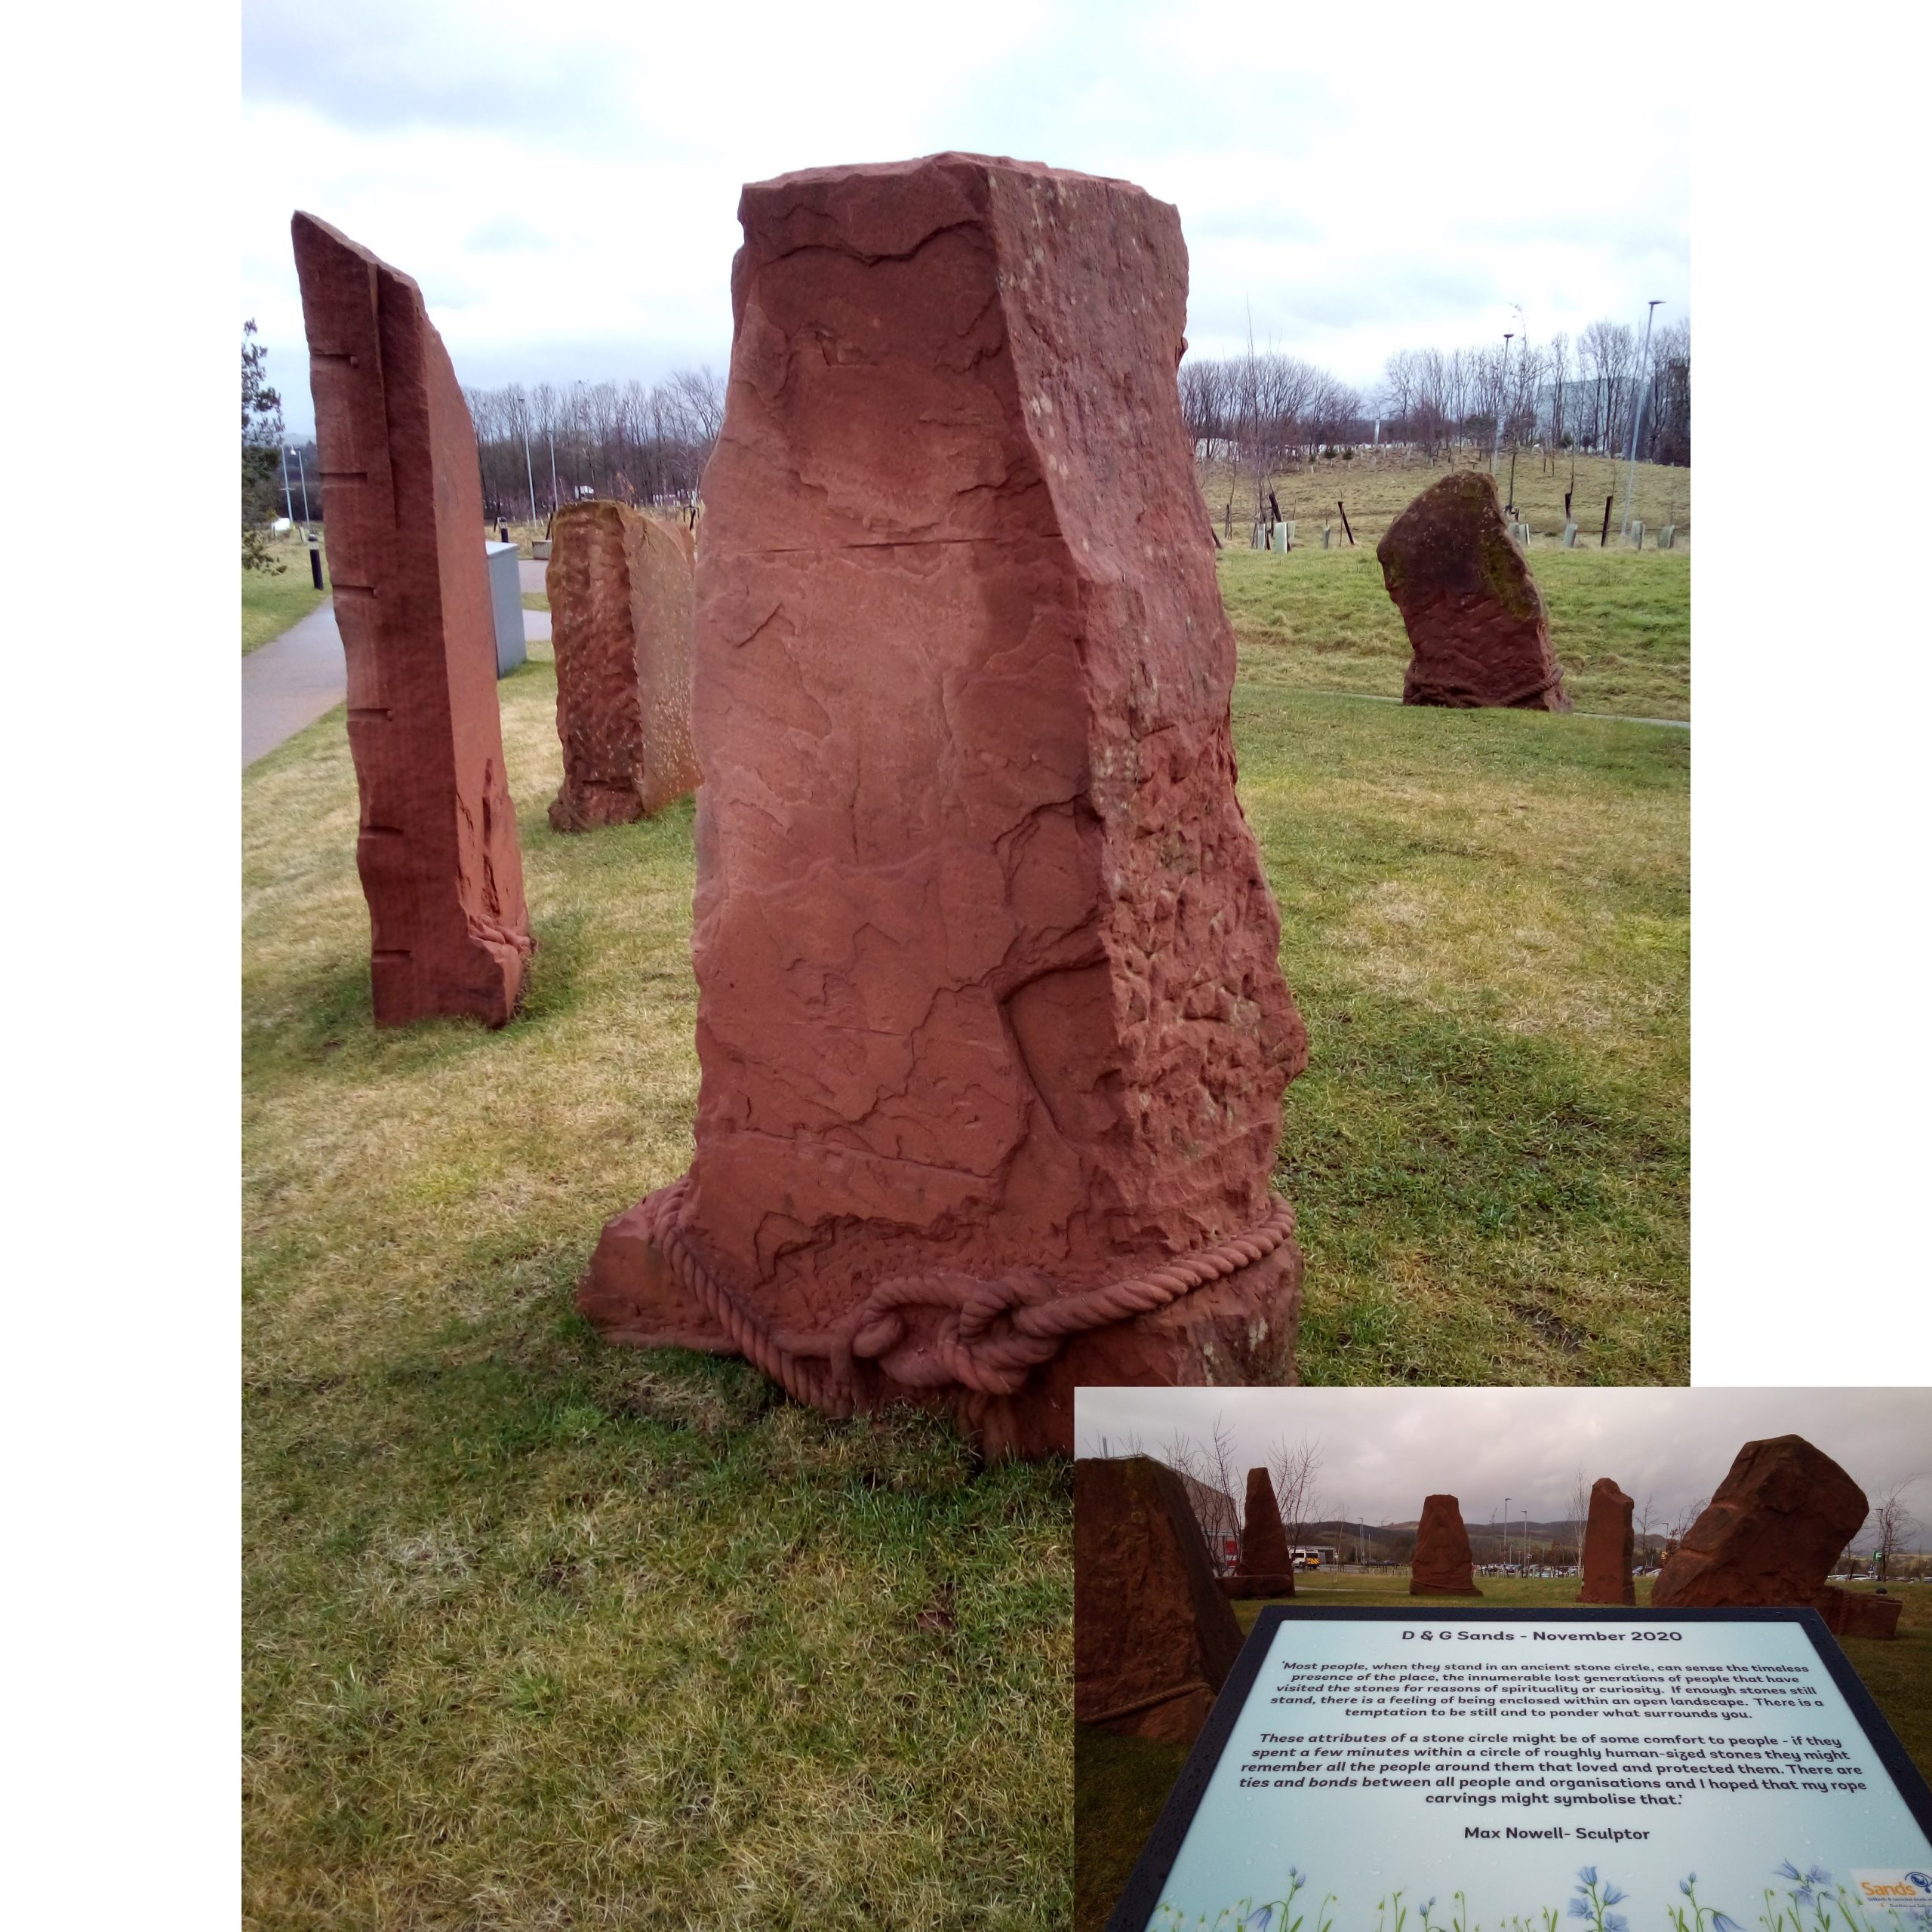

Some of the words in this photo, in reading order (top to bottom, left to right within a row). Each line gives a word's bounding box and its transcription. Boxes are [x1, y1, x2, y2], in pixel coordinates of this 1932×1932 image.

[1402, 1631, 1414, 1639] D
[1420, 1631, 1433, 1641] &
[1439, 1632, 1451, 1640] G
[1457, 1631, 1514, 1640] Sands
[1534, 1632, 1626, 1641] November
[1631, 1632, 1682, 1641] 2020
[1321, 1663, 1367, 1672] people,
[1411, 1663, 1440, 1672] they
[1399, 1674, 1438, 1682] place,
[1584, 1675, 1665, 1684] generations
[1685, 1675, 1730, 1684] people
[1502, 1685, 1578, 1694] spirituality
[1600, 1686, 1664, 1695] curiosity.
[1685, 1686, 1737, 1696] enough
[1270, 1696, 1315, 1705] stand,
[1389, 1696, 1436, 1706] feeling
[1459, 1696, 1495, 1706] being
[1671, 1697, 1748, 1708] landscape.
[1346, 1708, 1426, 1718] temptation
[1470, 1708, 1497, 1716] still
[1550, 1709, 1599, 1718] ponder
[1603, 1709, 1640, 1717] what
[1644, 1709, 1718, 1718] surrounds
[1260, 1734, 1304, 1743] These
[1309, 1734, 1386, 1743] attributes
[1391, 1734, 1407, 1742] of
[1469, 1734, 1508, 1742] circle
[1512, 1734, 1556, 1745] might
[1560, 1734, 1577, 1743] be
[1582, 1734, 1596, 1743] of
[1644, 1735, 1706, 1744] comfort
[1728, 1736, 1778, 1747] people
[1791, 1737, 1802, 1745] if
[1806, 1737, 1841, 1748] they
[1251, 1749, 1297, 1759] spent
[1315, 1747, 1343, 1756] few
[1347, 1747, 1409, 1756] minutes
[1414, 1747, 1462, 1756] within
[1480, 1747, 1520, 1756] circle
[1525, 1748, 1540, 1756] of
[1544, 1748, 1601, 1760] roughly
[1605, 1748, 1706, 1761] human-sized
[1710, 1750, 1761, 1758] stones
[1764, 1750, 1801, 1761] they
[1804, 1750, 1850, 1762] might
[1241, 1761, 1323, 1771] remember
[1327, 1762, 1346, 1771] all
[1350, 1761, 1375, 1771] the
[1380, 1761, 1430, 1774] people
[1435, 1761, 1490, 1771] around
[1494, 1761, 1534, 1771] them
[1539, 1762, 1573, 1771] that
[1577, 1762, 1618, 1772] loved
[1623, 1763, 1652, 1772] and
[1656, 1764, 1734, 1775] protected
[1737, 1764, 1784, 1774] them.
[1786, 1764, 1833, 1774] There
[1240, 1777, 1269, 1787] ties
[1274, 1777, 1305, 1787] and
[1309, 1777, 1358, 1787] bonds
[1362, 1777, 1431, 1786] between
[1436, 1777, 1454, 1786] all
[1460, 1777, 1510, 1789] people
[1515, 1777, 1545, 1786] and
[1550, 1777, 1661, 1790] organisations
[1666, 1779, 1697, 1789] and
[1700, 1779, 1705, 1789] I
[1709, 1779, 1759, 1792] hoped
[1761, 1780, 1798, 1789] that
[1801, 1783, 1828, 1792] my
[1831, 1783, 1866, 1793] rope
[1426, 1792, 1496, 1806] carvings
[1501, 1793, 1549, 1806] might
[1554, 1793, 1636, 1807] symbolise
[1465, 1827, 1500, 1838] Max
[1576, 1828, 1650, 1843] Sculptor
[1861, 1881, 1916, 1896] Sands
